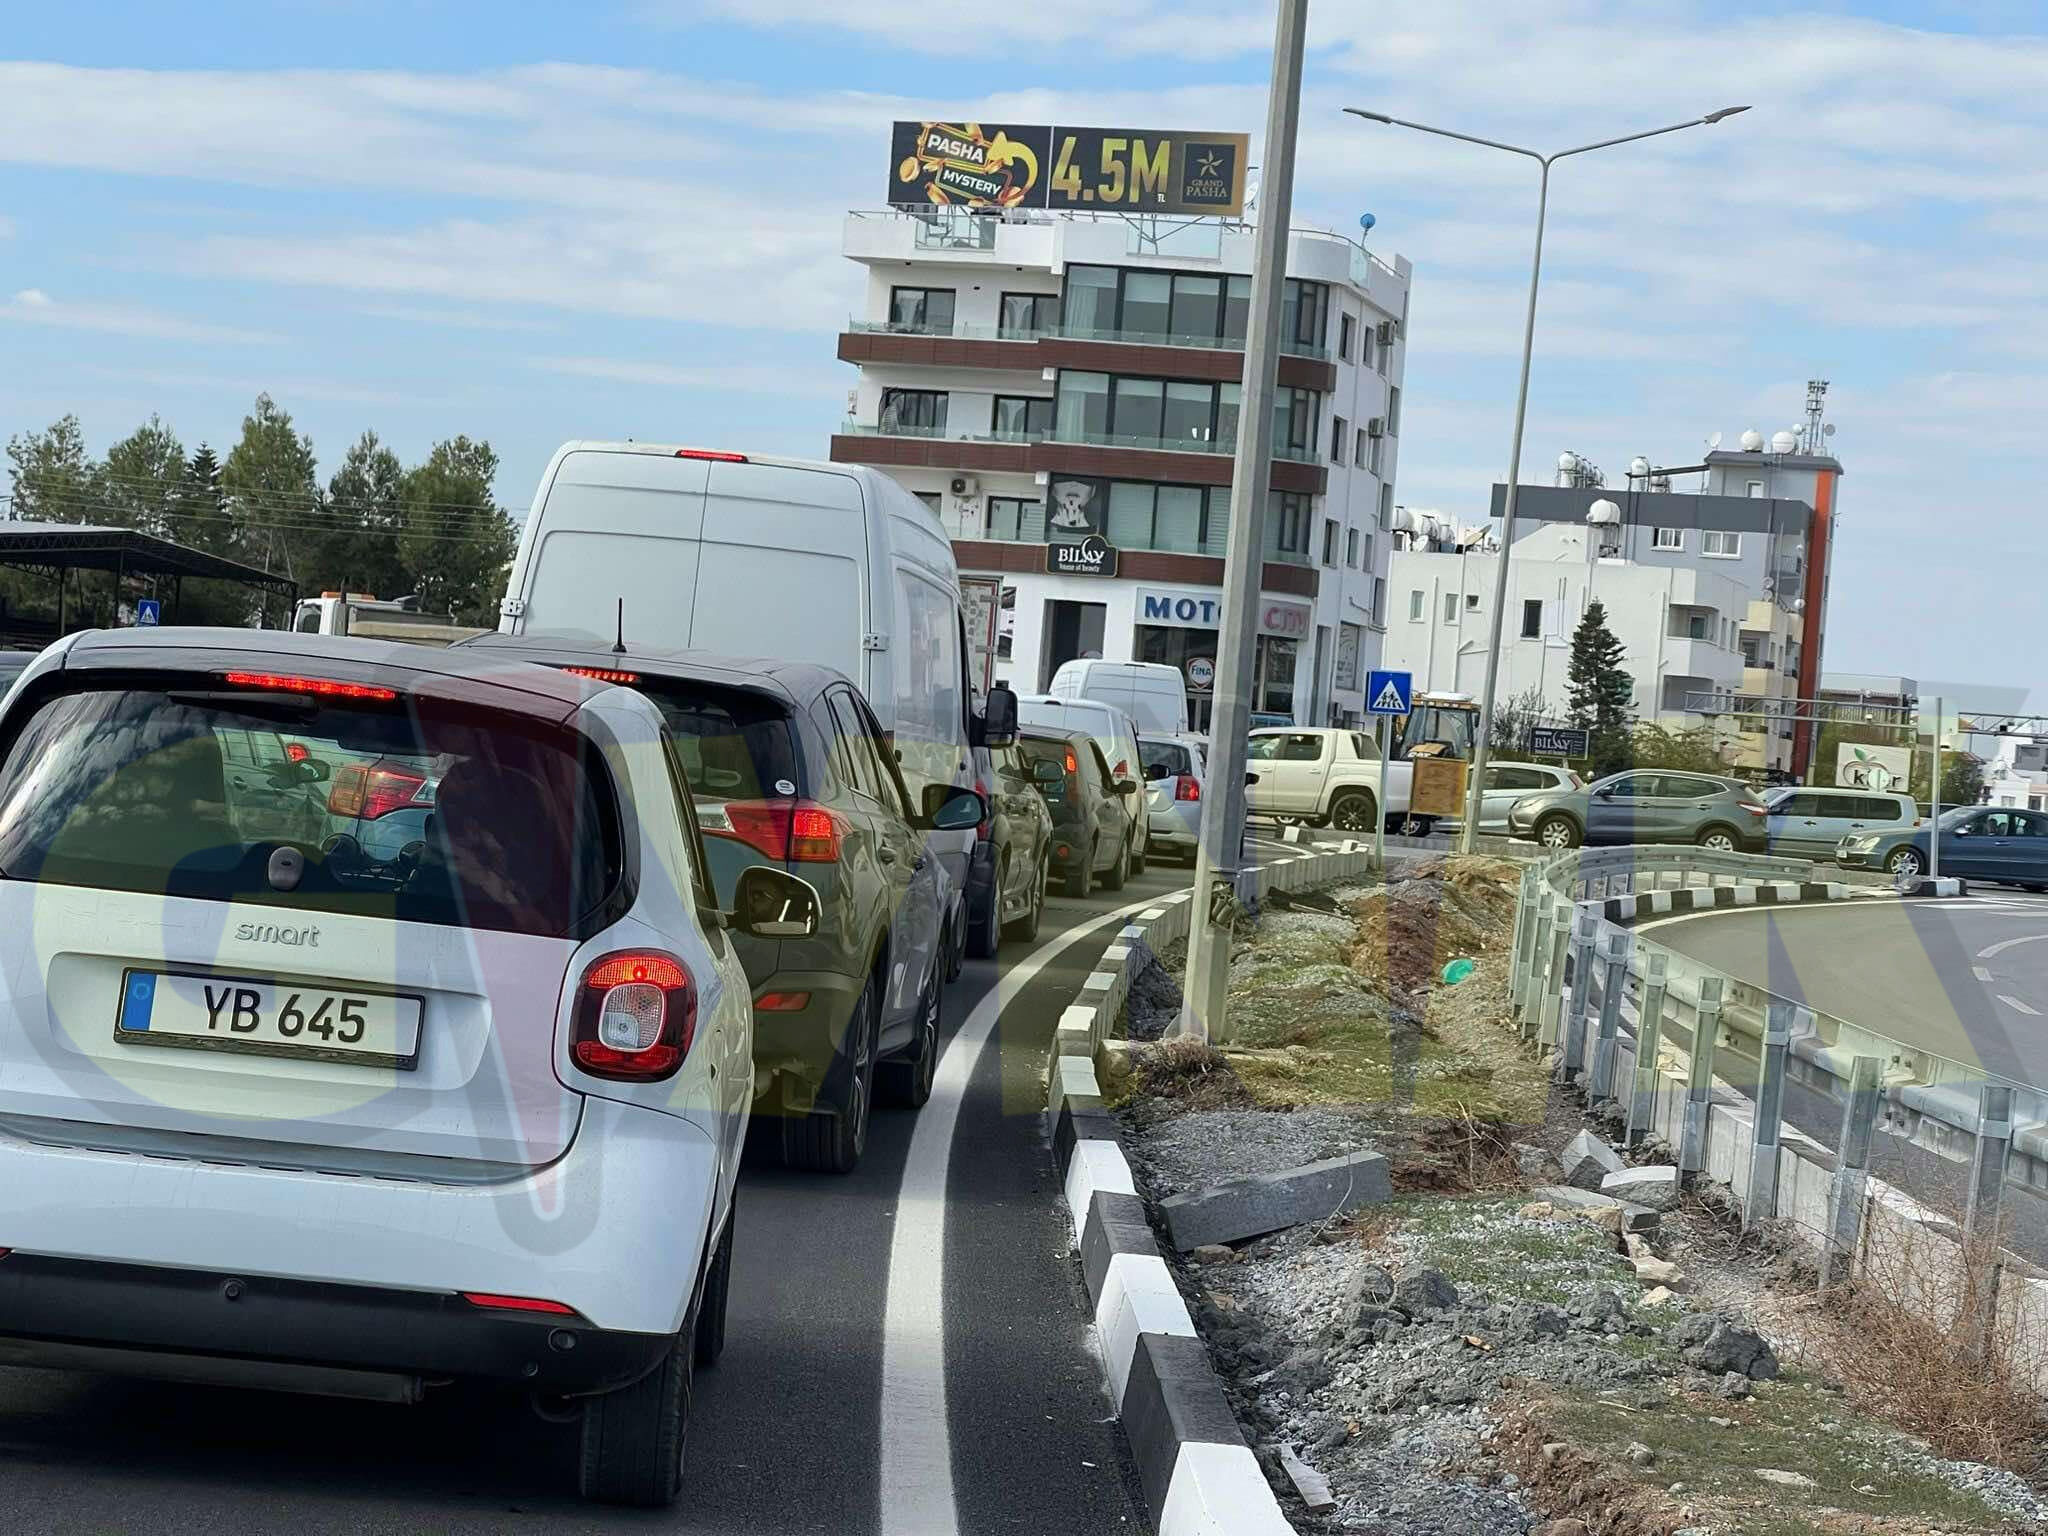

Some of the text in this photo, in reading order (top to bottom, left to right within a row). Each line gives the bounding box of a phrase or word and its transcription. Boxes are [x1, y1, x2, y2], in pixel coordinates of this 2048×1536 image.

[927, 134, 985, 164] PASHA
[942, 169, 1003, 195] MYSTERY
[1051, 136, 1171, 204] 4.5M
[1191, 178, 1224, 188] GRAND
[1186, 186, 1228, 198] PASHA
[1144, 595, 1223, 623] MOT
[1191, 664, 1212, 676] FINA
[234, 920, 322, 948] smart
[203, 985, 369, 1044] YB 645
